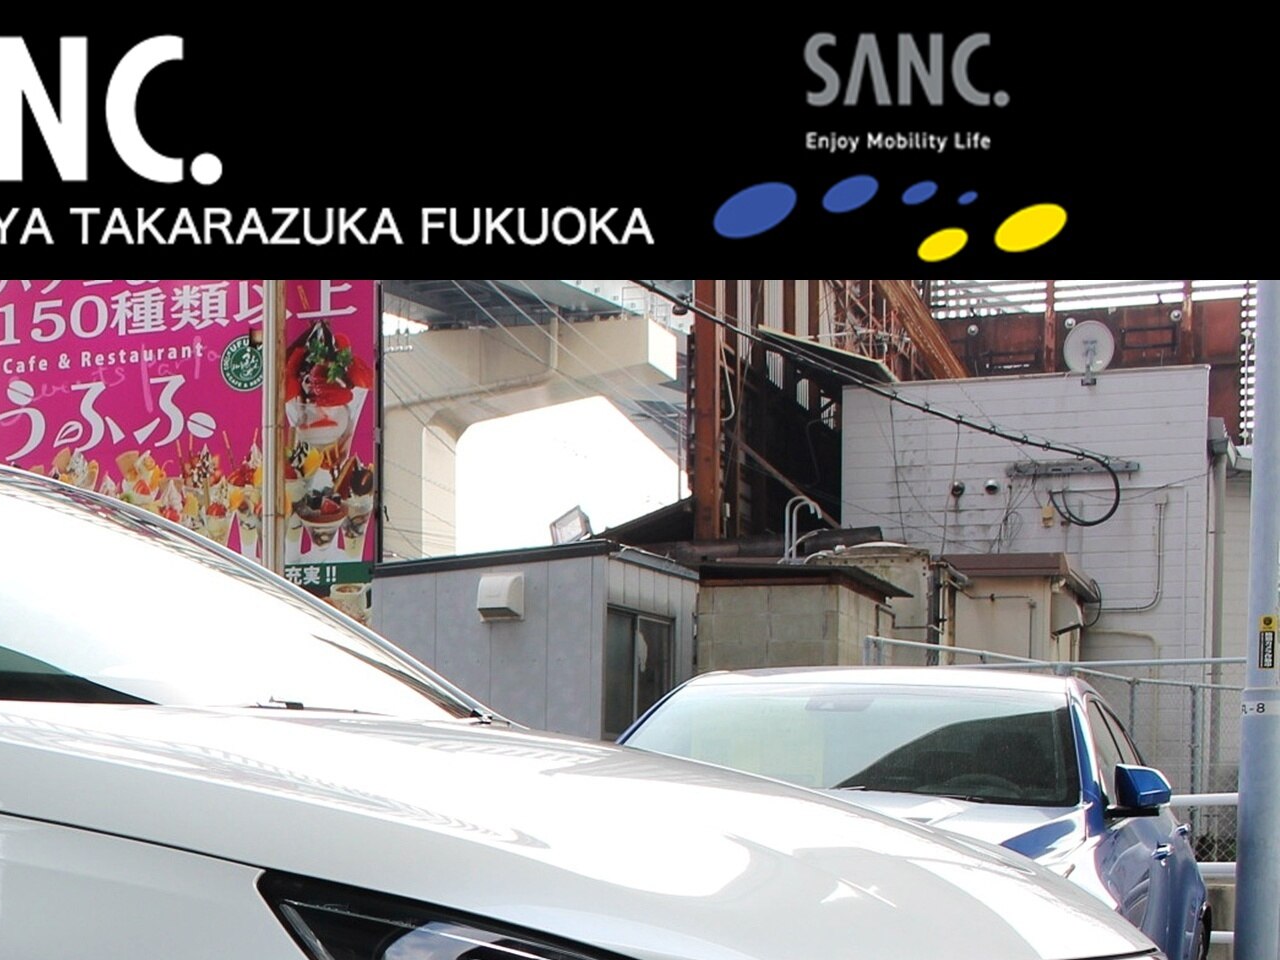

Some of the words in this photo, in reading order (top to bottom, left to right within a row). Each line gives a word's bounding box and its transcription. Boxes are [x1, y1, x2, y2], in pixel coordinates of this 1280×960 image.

[2, 355, 48, 374] Cafe
[58, 353, 71, 369] &
[81, 342, 204, 367] Restaurant
